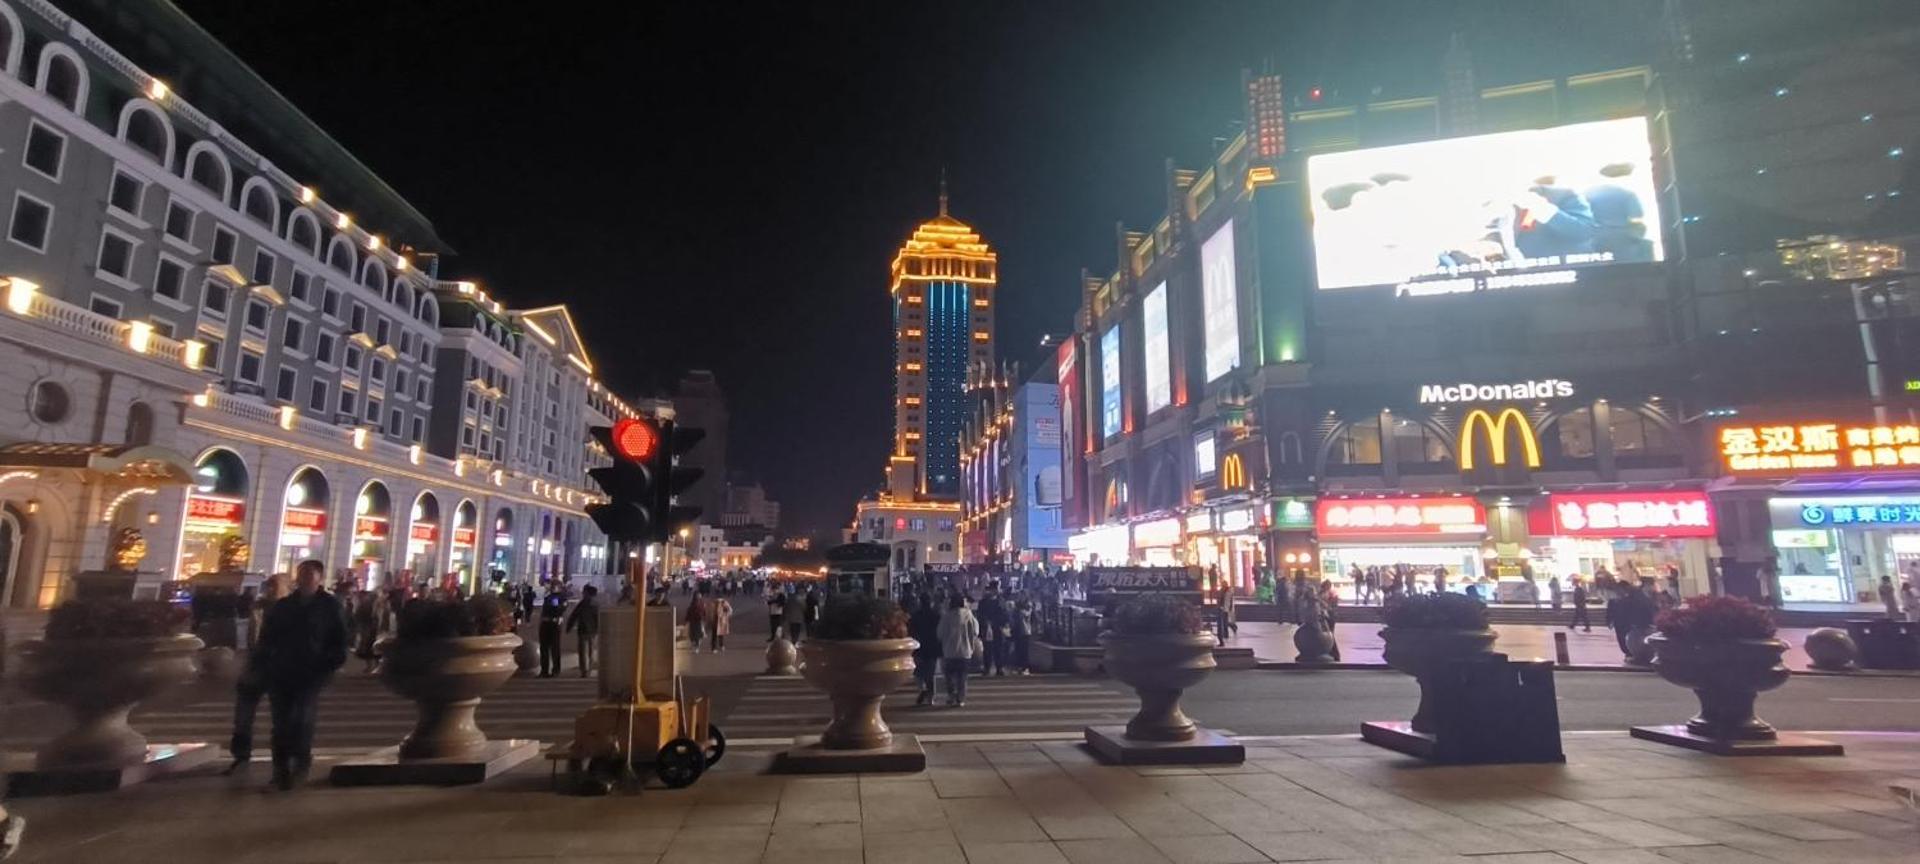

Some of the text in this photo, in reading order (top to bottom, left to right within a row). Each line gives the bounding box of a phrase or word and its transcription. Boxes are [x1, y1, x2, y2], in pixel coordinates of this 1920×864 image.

[1420, 379, 1574, 404] McDonald's
[1722, 425, 1839, 455] 金汉斯
